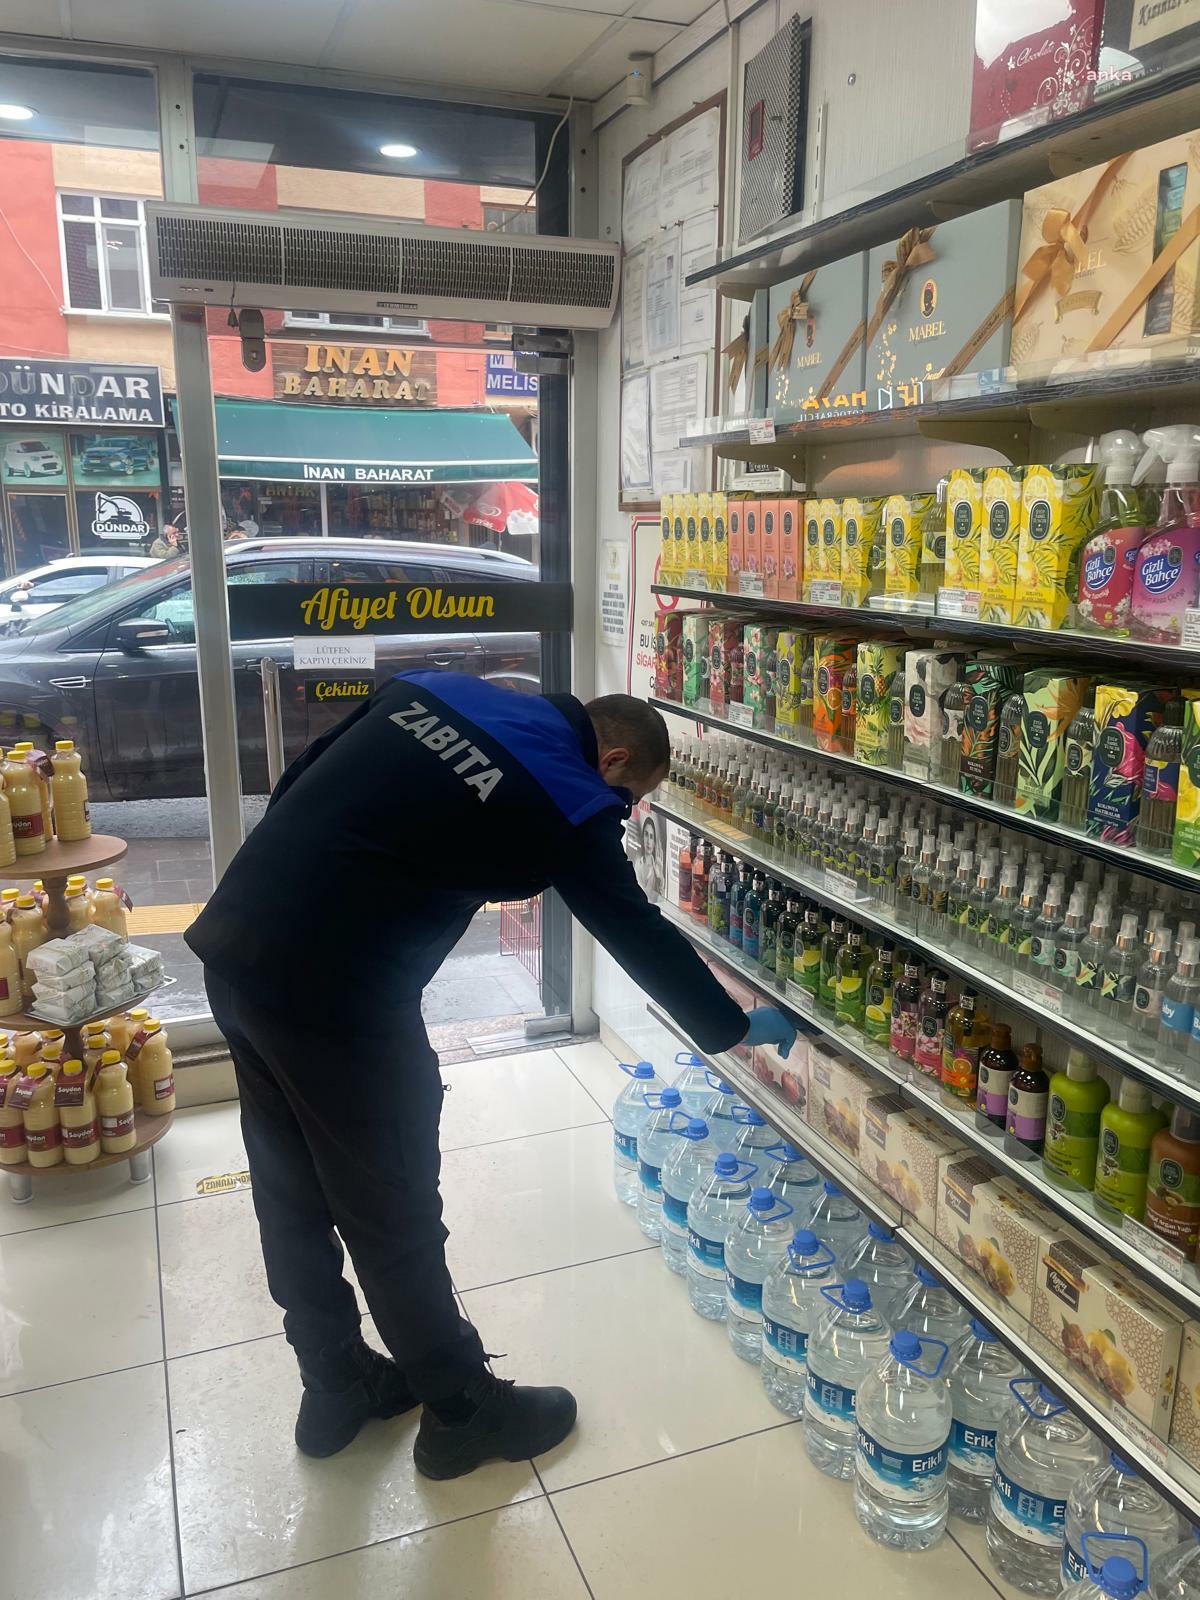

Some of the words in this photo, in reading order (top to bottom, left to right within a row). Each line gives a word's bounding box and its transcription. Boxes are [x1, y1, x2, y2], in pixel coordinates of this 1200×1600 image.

[908, 320, 946, 343] MABEL
[796, 351, 823, 369] MABEL
[283, 372, 431, 401] BAHARAT
[0, 403, 26, 417] TO
[35, 401, 153, 422] KİRALAMA
[304, 464, 345, 480] İNAN
[355, 468, 434, 481] BAHARAT
[96, 521, 145, 533] DÜNDAR
[1085, 556, 1101, 573] Gizli
[1142, 558, 1164, 577] Gizli
[1086, 566, 1113, 583] Bahçe
[1145, 567, 1179, 587] Bahçe
[300, 587, 398, 631] Afiyet
[406, 587, 495, 619] Olsun
[316, 645, 351, 654] LÜTFEN
[639, 634, 650, 649] BU
[299, 657, 332, 665] KAPIYI
[332, 656, 367, 666] ÇEKİNİZ
[636, 651, 657, 669] SİGAR
[315, 681, 369, 701] Çekiniz
[388, 701, 504, 802] ZABITA
[965, 1430, 995, 1449] Erik
[912, 1450, 943, 1472] Erikli
